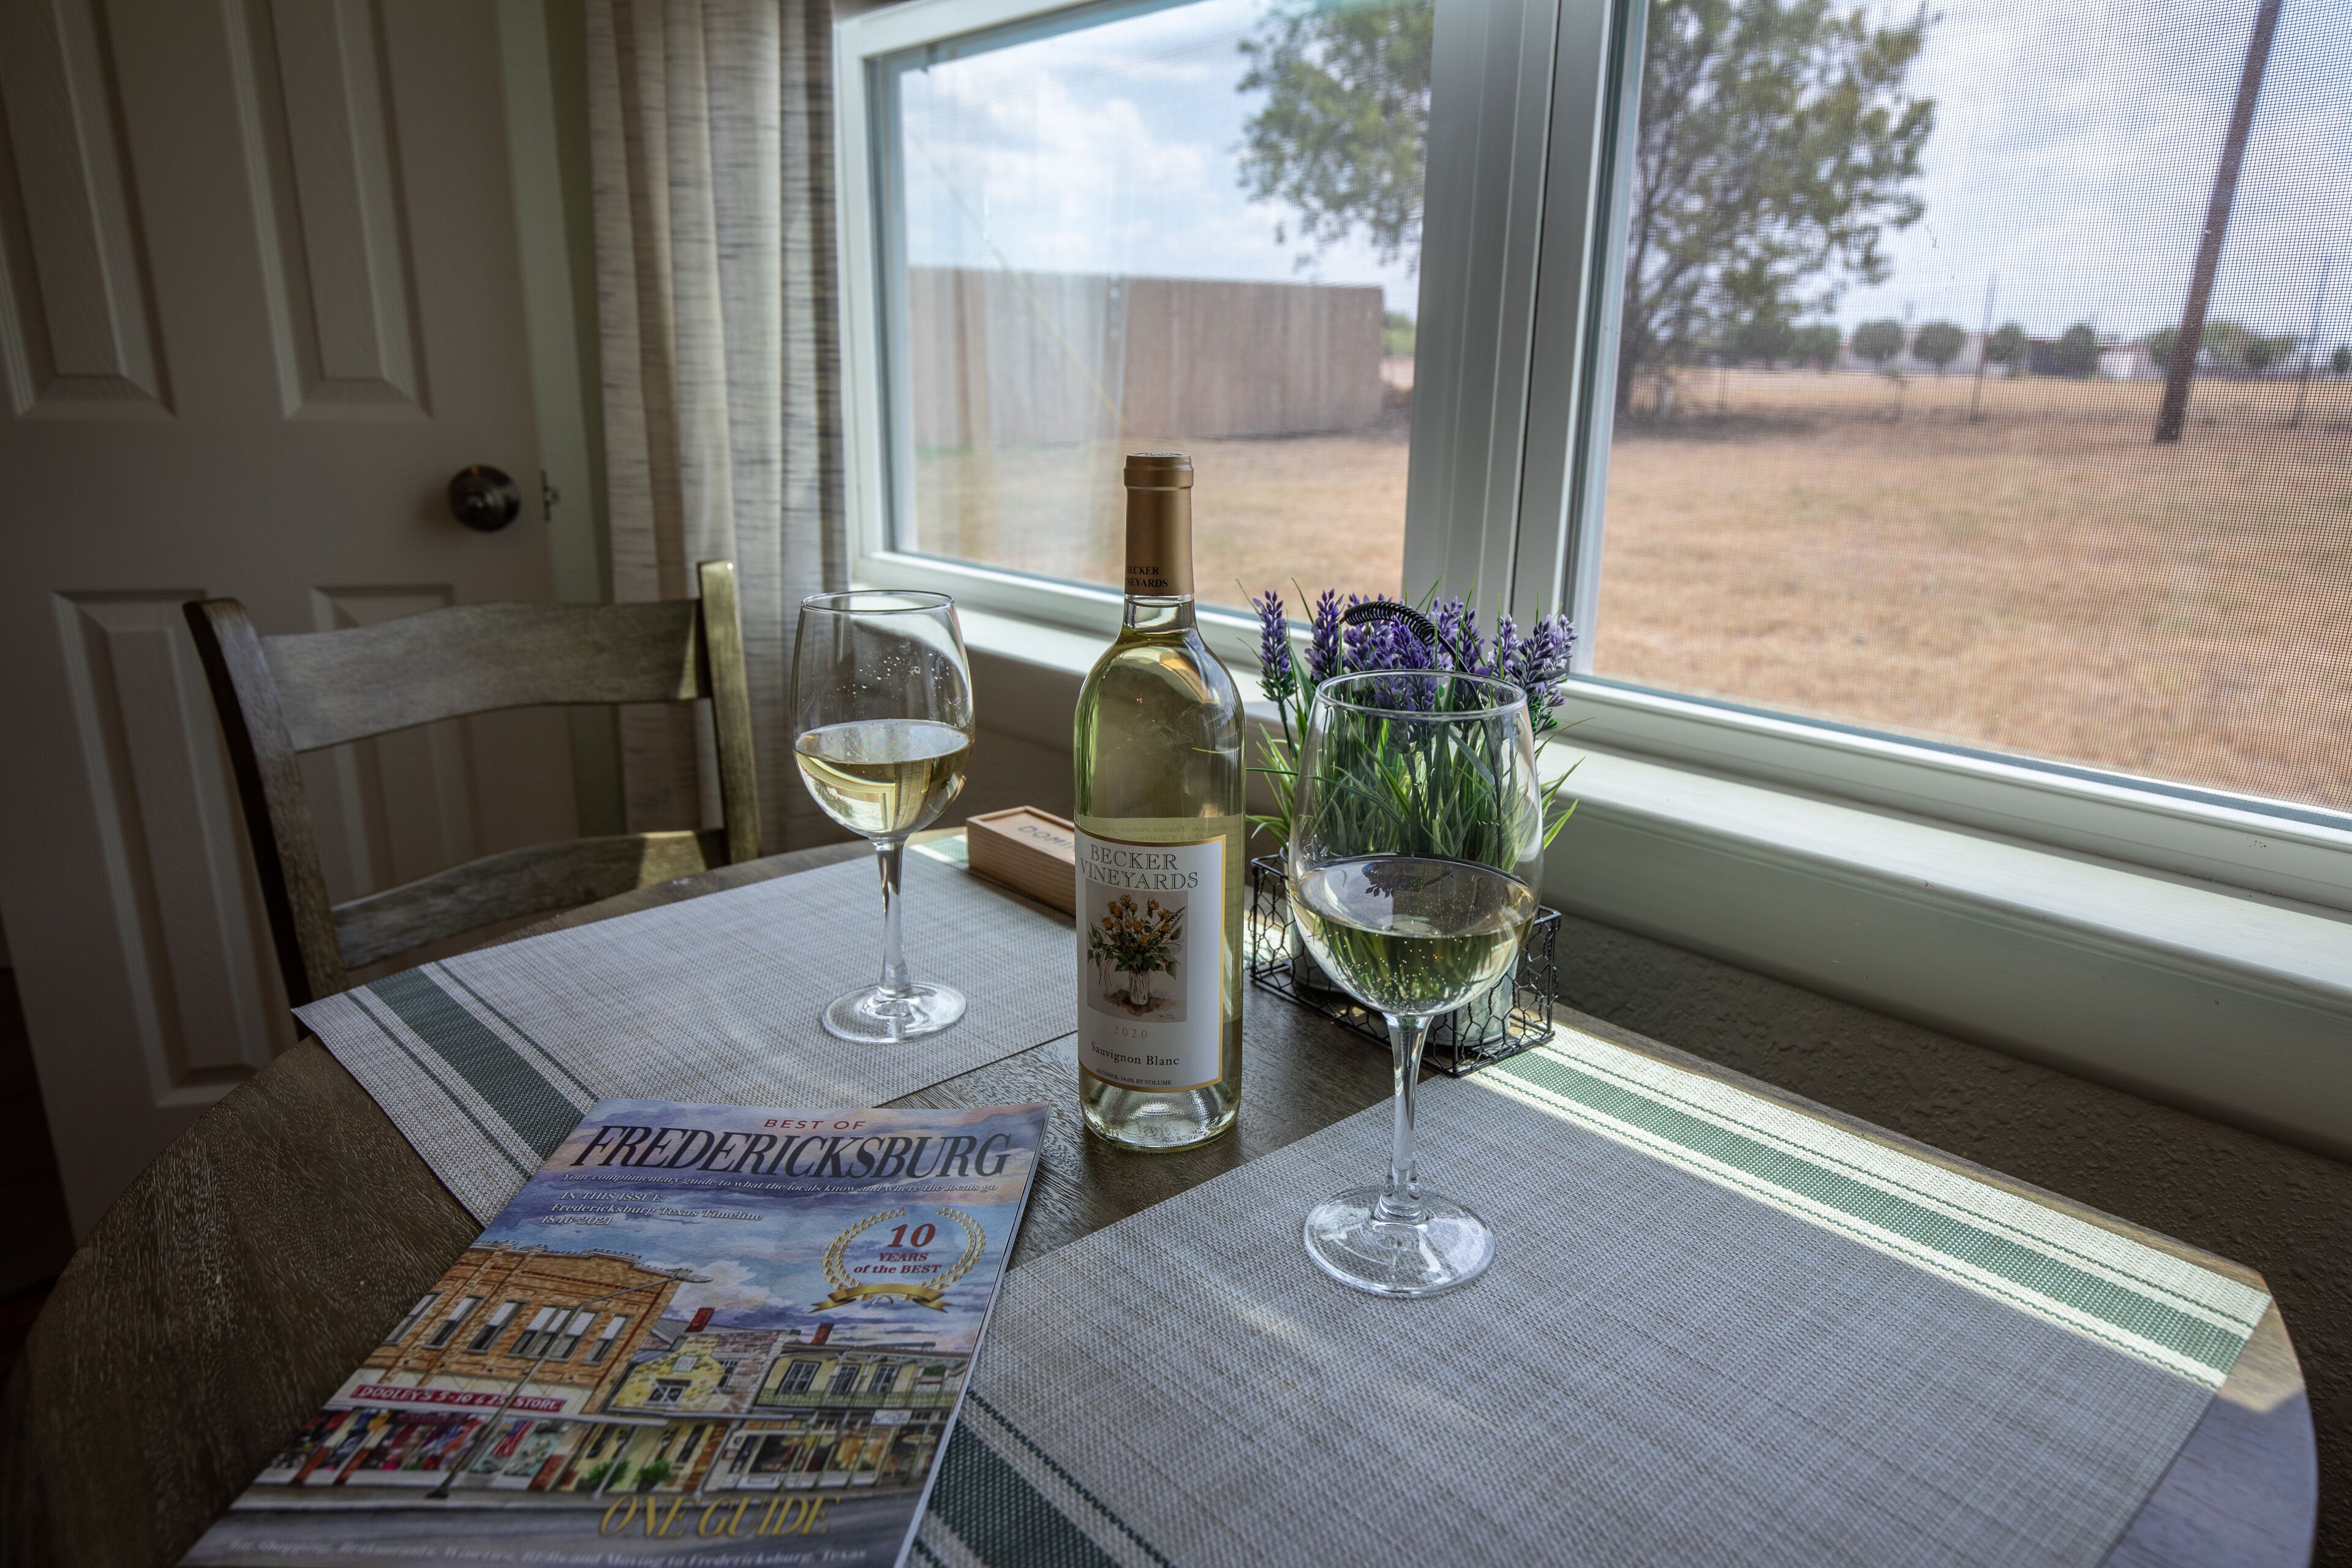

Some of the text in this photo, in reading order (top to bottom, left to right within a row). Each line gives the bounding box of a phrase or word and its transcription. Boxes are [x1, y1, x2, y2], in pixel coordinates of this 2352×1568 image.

[1126, 566, 1159, 575] BECKER
[1126, 578, 1168, 587] NEYARDS
[1090, 843, 1178, 870] BECKER
[1080, 858, 1198, 890] VINEYARDS
[1114, 1025, 1147, 1039] 2020
[1091, 1041, 1179, 1066] Sauvignon Blanc
[1096, 1068, 1119, 1080] ALCOHOL
[764, 1119, 866, 1130] BEST OF
[569, 1125, 1011, 1179] FREDERICKSBURG
[592, 1174, 679, 1185] complimentary
[682, 1178, 718, 1187] guide
[734, 1180, 764, 1189] what
[787, 1183, 821, 1192] locals
[922, 1184, 944, 1193] the
[581, 1192, 618, 1201] THIS
[619, 1193, 667, 1203] ISSUE:
[550, 1204, 764, 1220] Fredericksburg Texas Timeline
[540, 1215, 613, 1226] 1846-2021
[887, 1223, 936, 1248] 10
[878, 1252, 929, 1262] YEARS
[853, 1264, 942, 1273] of the BEST
[600, 1494, 842, 1538] ONE GUIDE
